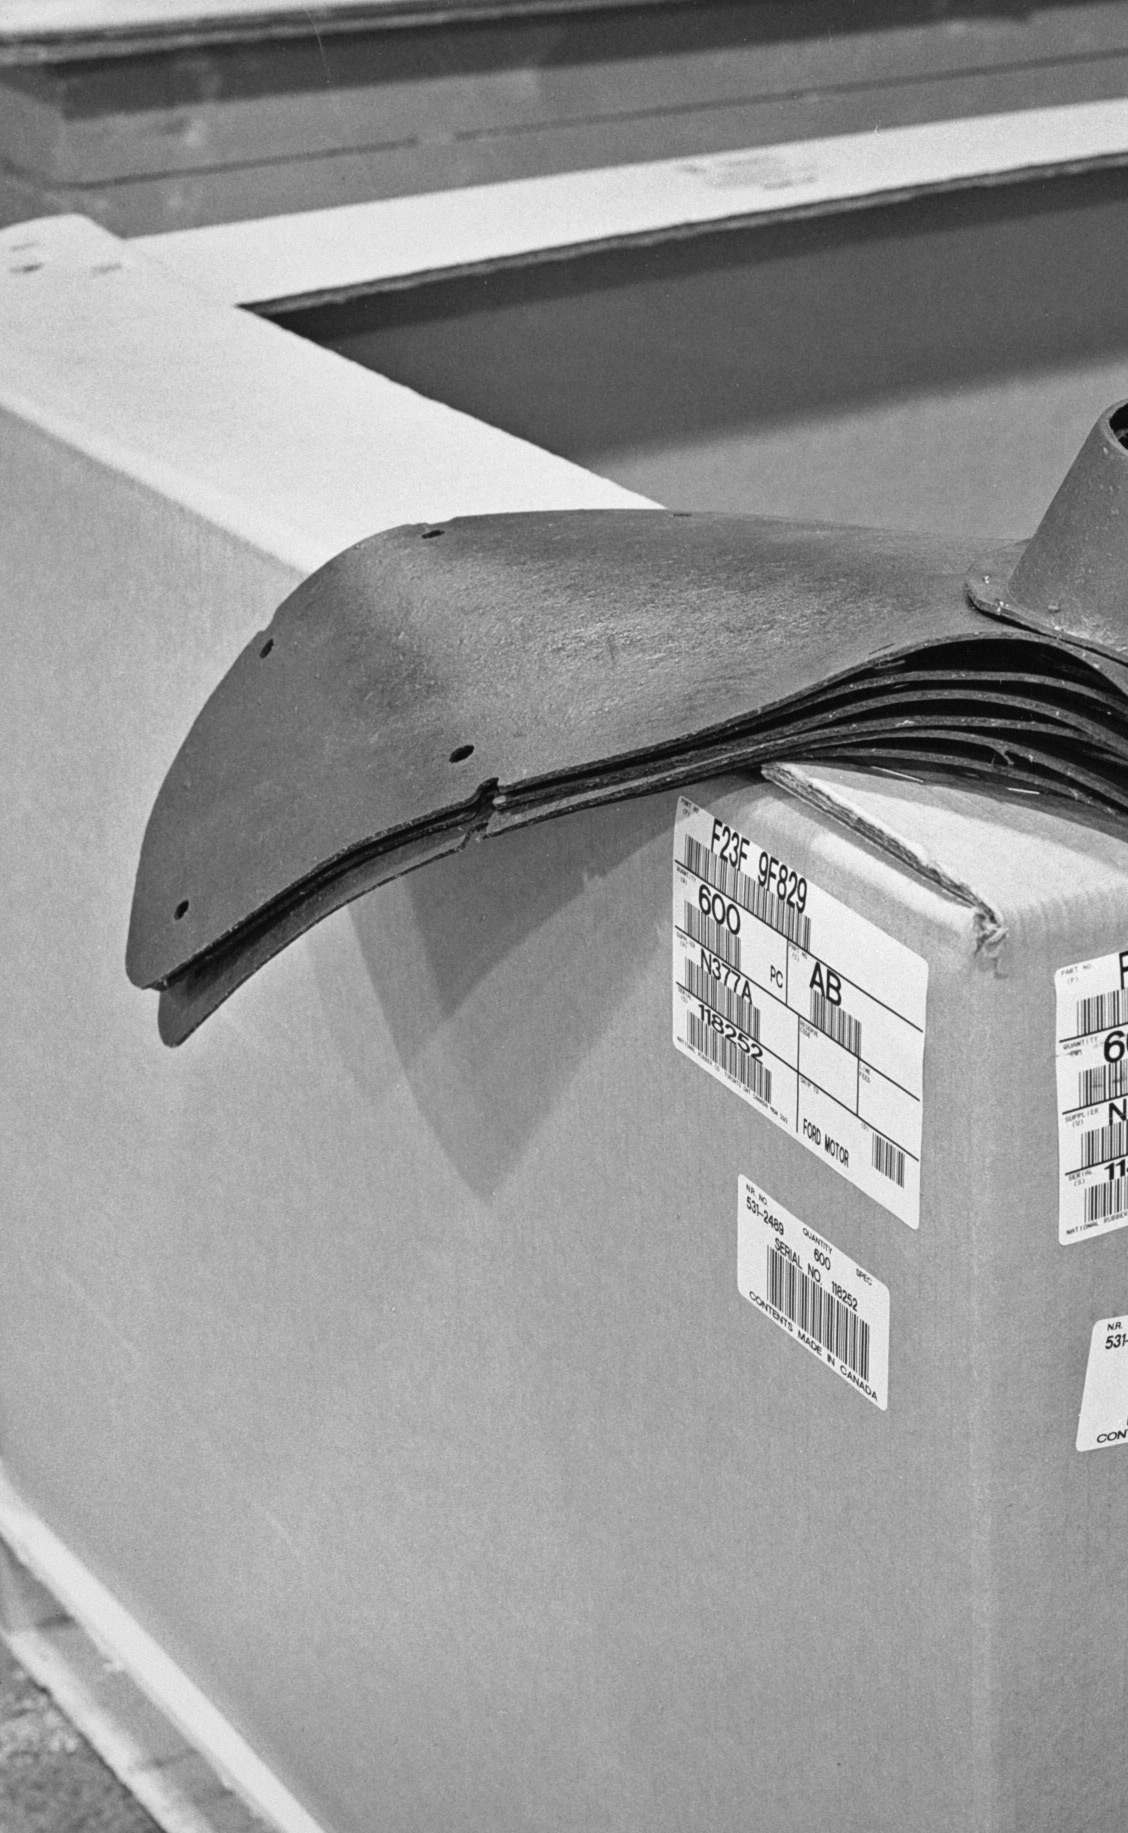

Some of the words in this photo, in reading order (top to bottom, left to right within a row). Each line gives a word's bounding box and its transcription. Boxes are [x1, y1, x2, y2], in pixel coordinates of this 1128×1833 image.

[711, 818, 750, 871] F23F
[758, 851, 808, 914] 9F829
[699, 884, 741, 935] 600
[701, 948, 753, 1005] N377A
[770, 964, 784, 989] PC
[809, 961, 842, 1006] AB
[698, 1004, 763, 1065] 118252
[1064, 1107, 1099, 1122] SUPPLIER
[802, 1118, 821, 1146] FORD
[824, 1134, 849, 1168] MOTOR
[1068, 1169, 1093, 1181] SERIAL
[746, 1196, 784, 1236] 531-2489
[1066, 1222, 1099, 1236] NATIONAL
[1103, 1211, 1128, 1224] RUBBER
[802, 1227, 833, 1254] QUANTITY
[813, 1248, 831, 1271] 600
[774, 1237, 803, 1270] SERIAL
[807, 1262, 823, 1285] NO.
[831, 1280, 858, 1312] 118252
[856, 1268, 873, 1286] SPEC
[749, 1290, 793, 1333] CONTENTS
[798, 1330, 823, 1356] MADE
[827, 1353, 836, 1366] IN
[840, 1364, 878, 1402] CANADA
